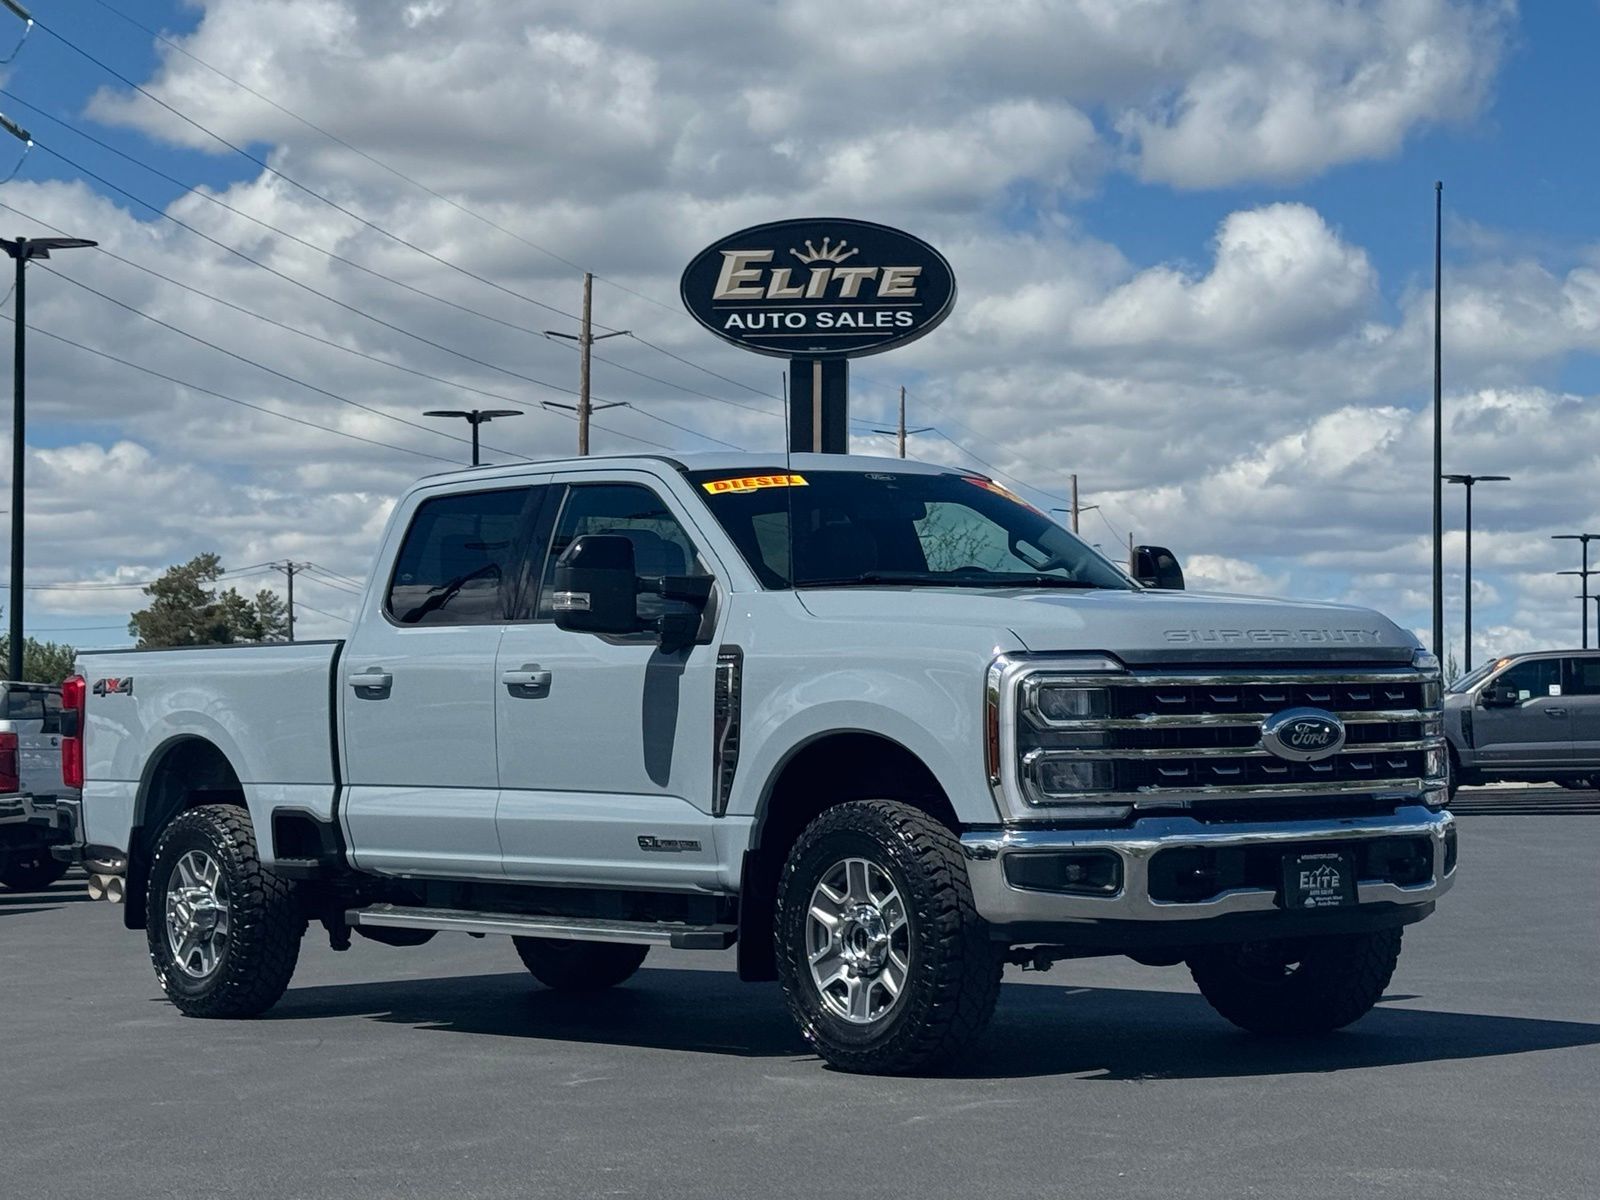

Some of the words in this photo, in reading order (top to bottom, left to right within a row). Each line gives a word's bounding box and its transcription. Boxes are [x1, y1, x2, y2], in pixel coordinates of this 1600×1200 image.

[712, 250, 923, 300] ELITE
[724, 312, 807, 329] AUTO
[815, 311, 913, 328] SALES
[713, 476, 801, 491] DIESEL
[1163, 629, 1298, 644] SUPER
[1299, 629, 1382, 643] DUTY
[1291, 722, 1330, 745] Ford
[1300, 871, 1340, 889] ELITE
